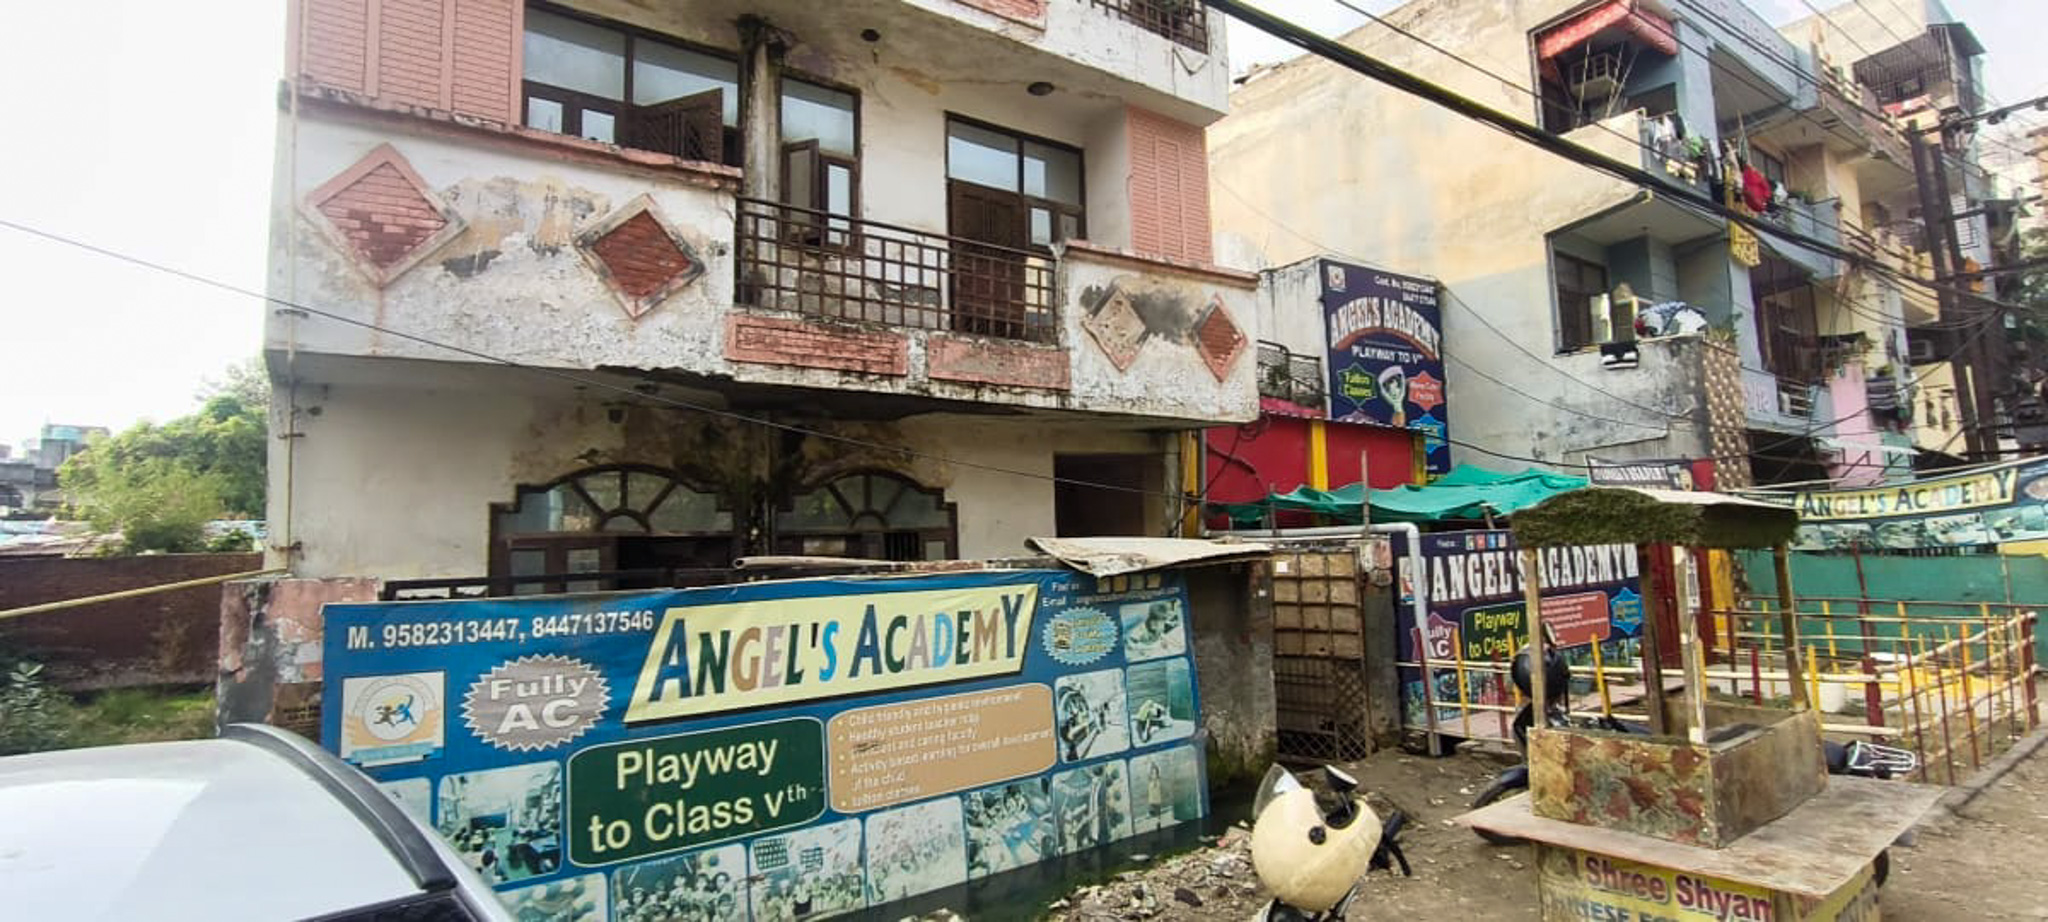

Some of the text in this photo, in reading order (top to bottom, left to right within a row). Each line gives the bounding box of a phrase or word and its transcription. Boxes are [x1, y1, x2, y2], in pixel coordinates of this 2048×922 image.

[1383, 297, 1440, 360] ACADEMY
[1801, 467, 2011, 517] ANGEL'S ACADEMY
[1537, 544, 1624, 588] ACADEMY
[347, 611, 655, 650] M. 9582313447, 8447137546
[1429, 626, 1451, 639] ully
[1474, 610, 1520, 633] Playway
[648, 617, 840, 702] ANGEL'S
[848, 593, 1026, 679] ACADEMY
[1469, 641, 1481, 659] to
[490, 673, 588, 701] Fully
[497, 698, 582, 735] AC
[617, 739, 778, 791] Playway
[588, 815, 632, 853] to
[644, 797, 754, 839] Class
[1585, 856, 1666, 902] Shree
